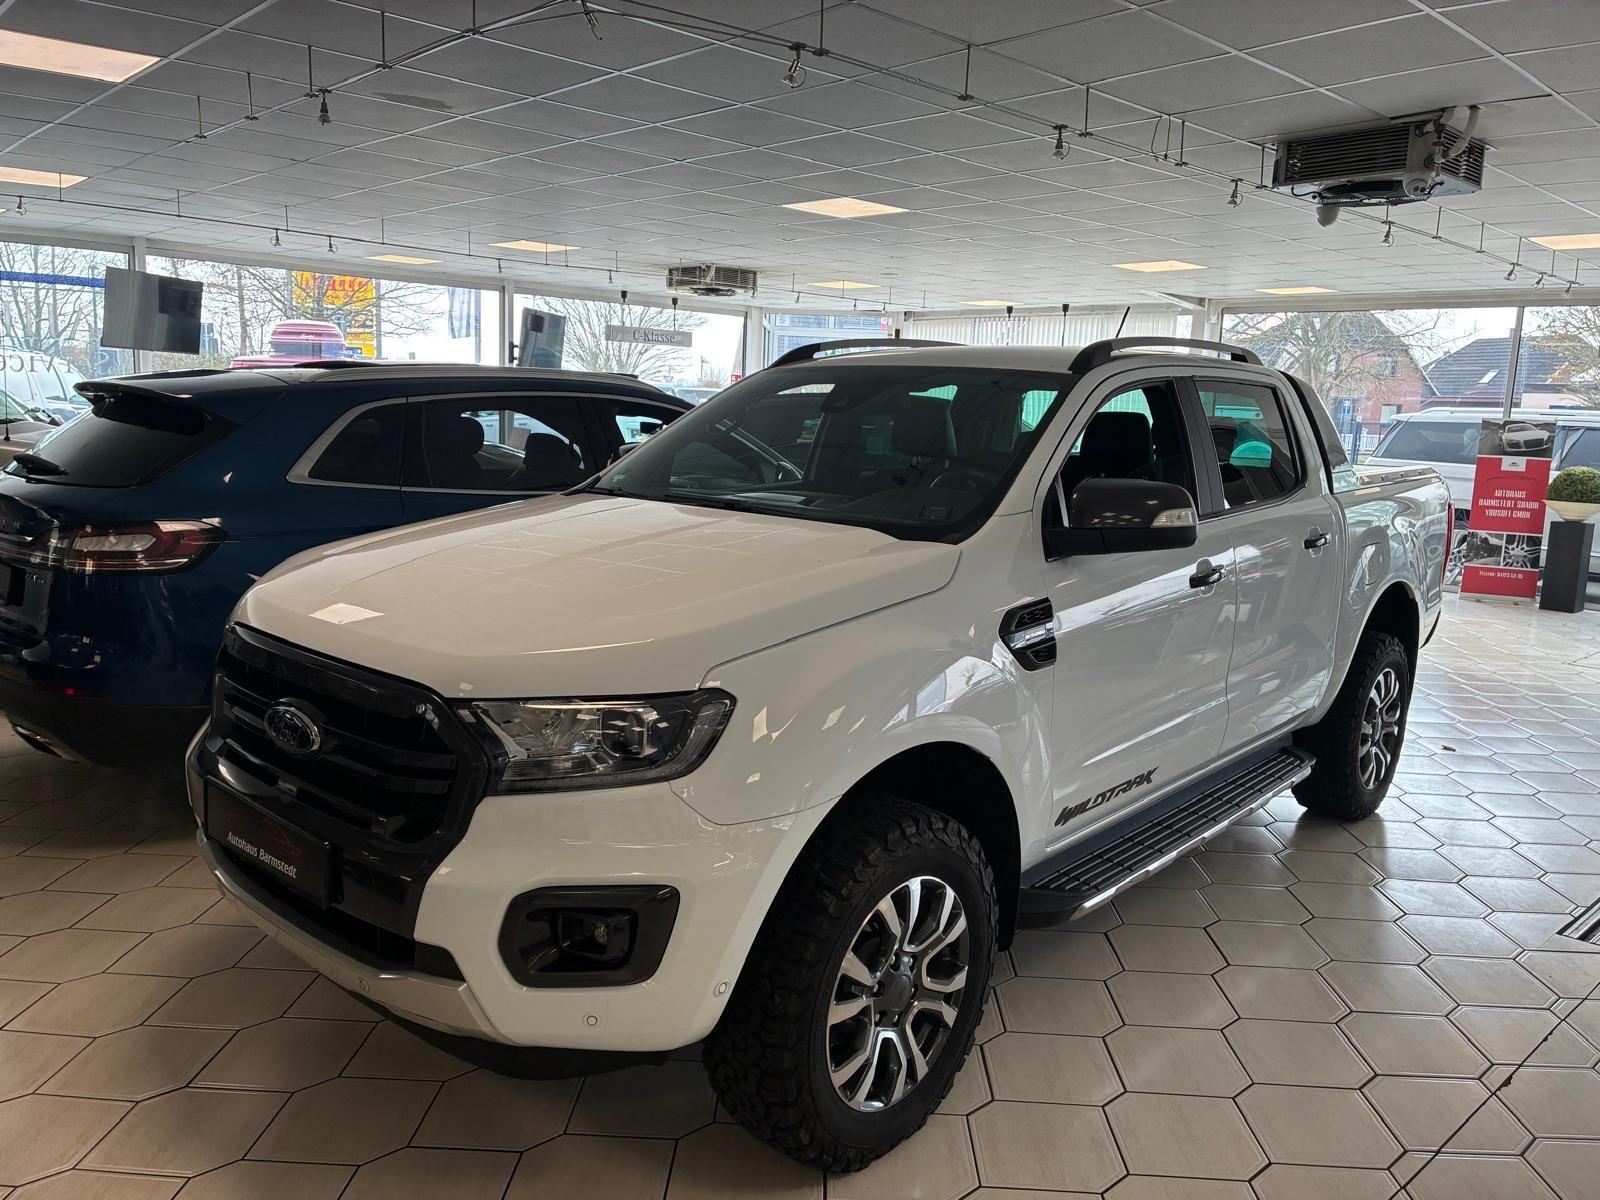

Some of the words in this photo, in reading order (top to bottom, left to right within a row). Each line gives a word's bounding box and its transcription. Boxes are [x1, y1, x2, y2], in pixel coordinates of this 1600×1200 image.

[632, 329, 675, 343] C-Klasse
[1494, 489, 1526, 498] AUTOHAUS
[1054, 766, 1160, 827] WILDTRAK
[227, 832, 258, 857] Autohaus
[259, 849, 297, 879] Barmstedt
